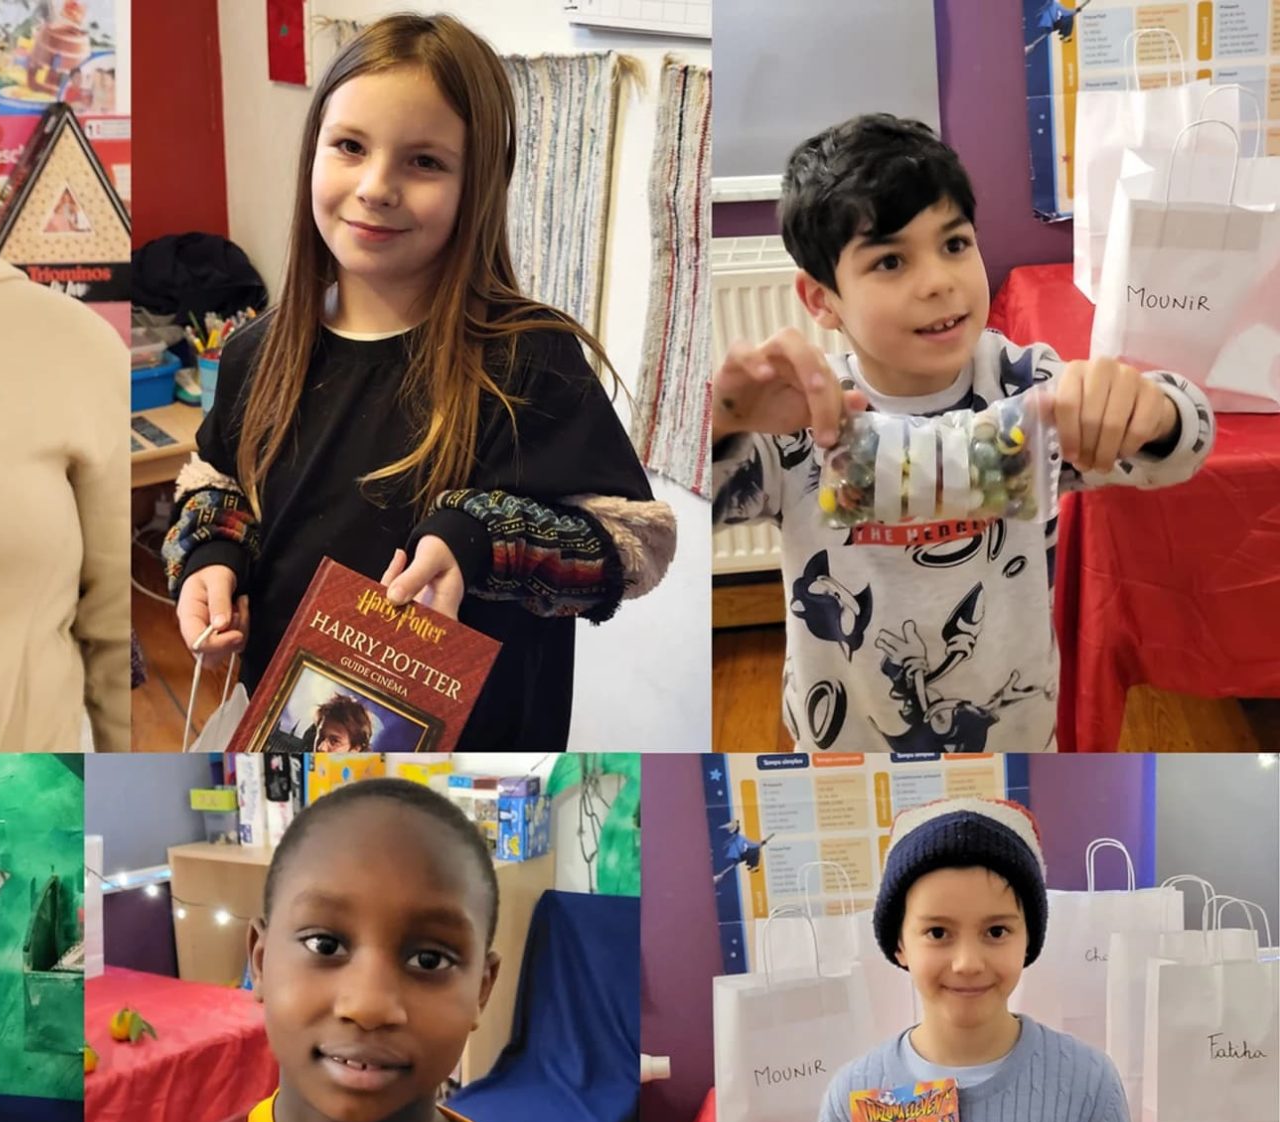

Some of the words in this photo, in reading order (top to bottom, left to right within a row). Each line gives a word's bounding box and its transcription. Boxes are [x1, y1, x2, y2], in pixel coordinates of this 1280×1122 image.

[310, 610, 381, 659] HARRY
[380, 645, 463, 700] POTTER
[340, 656, 372, 679] GUIDE
[370, 671, 409, 697] CINÉMA
[1208, 1032, 1268, 1060] Fatiha
